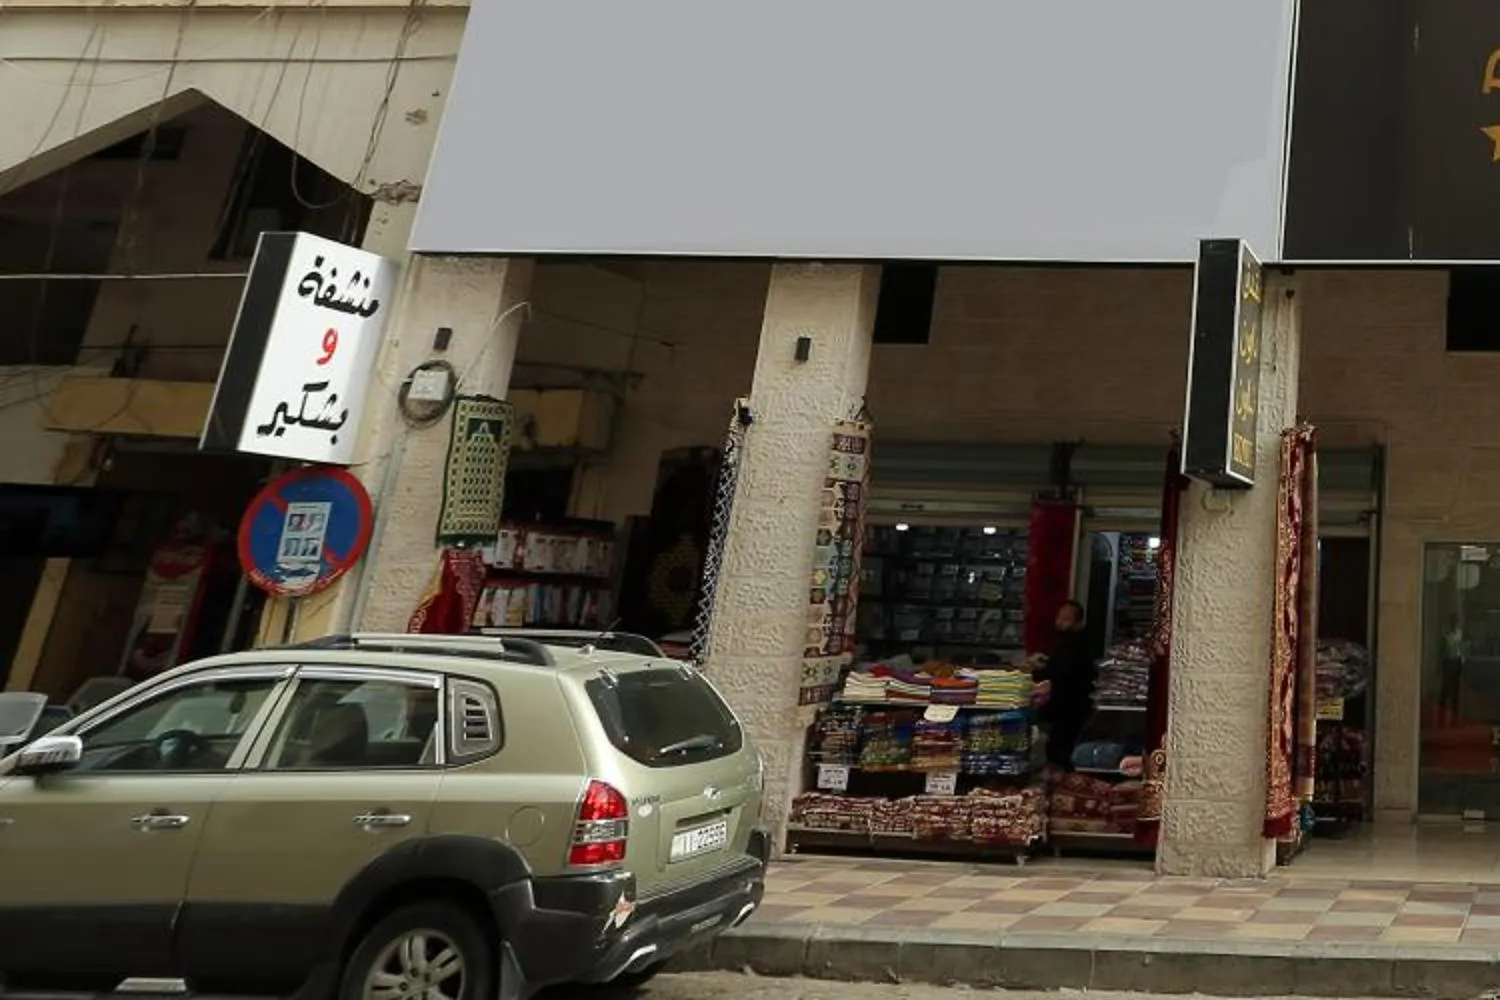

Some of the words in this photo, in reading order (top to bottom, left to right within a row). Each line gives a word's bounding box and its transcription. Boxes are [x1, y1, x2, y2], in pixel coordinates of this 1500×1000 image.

[297, 256, 380, 318] منشفة
[316, 328, 338, 365] و
[257, 381, 349, 445] بشكير
